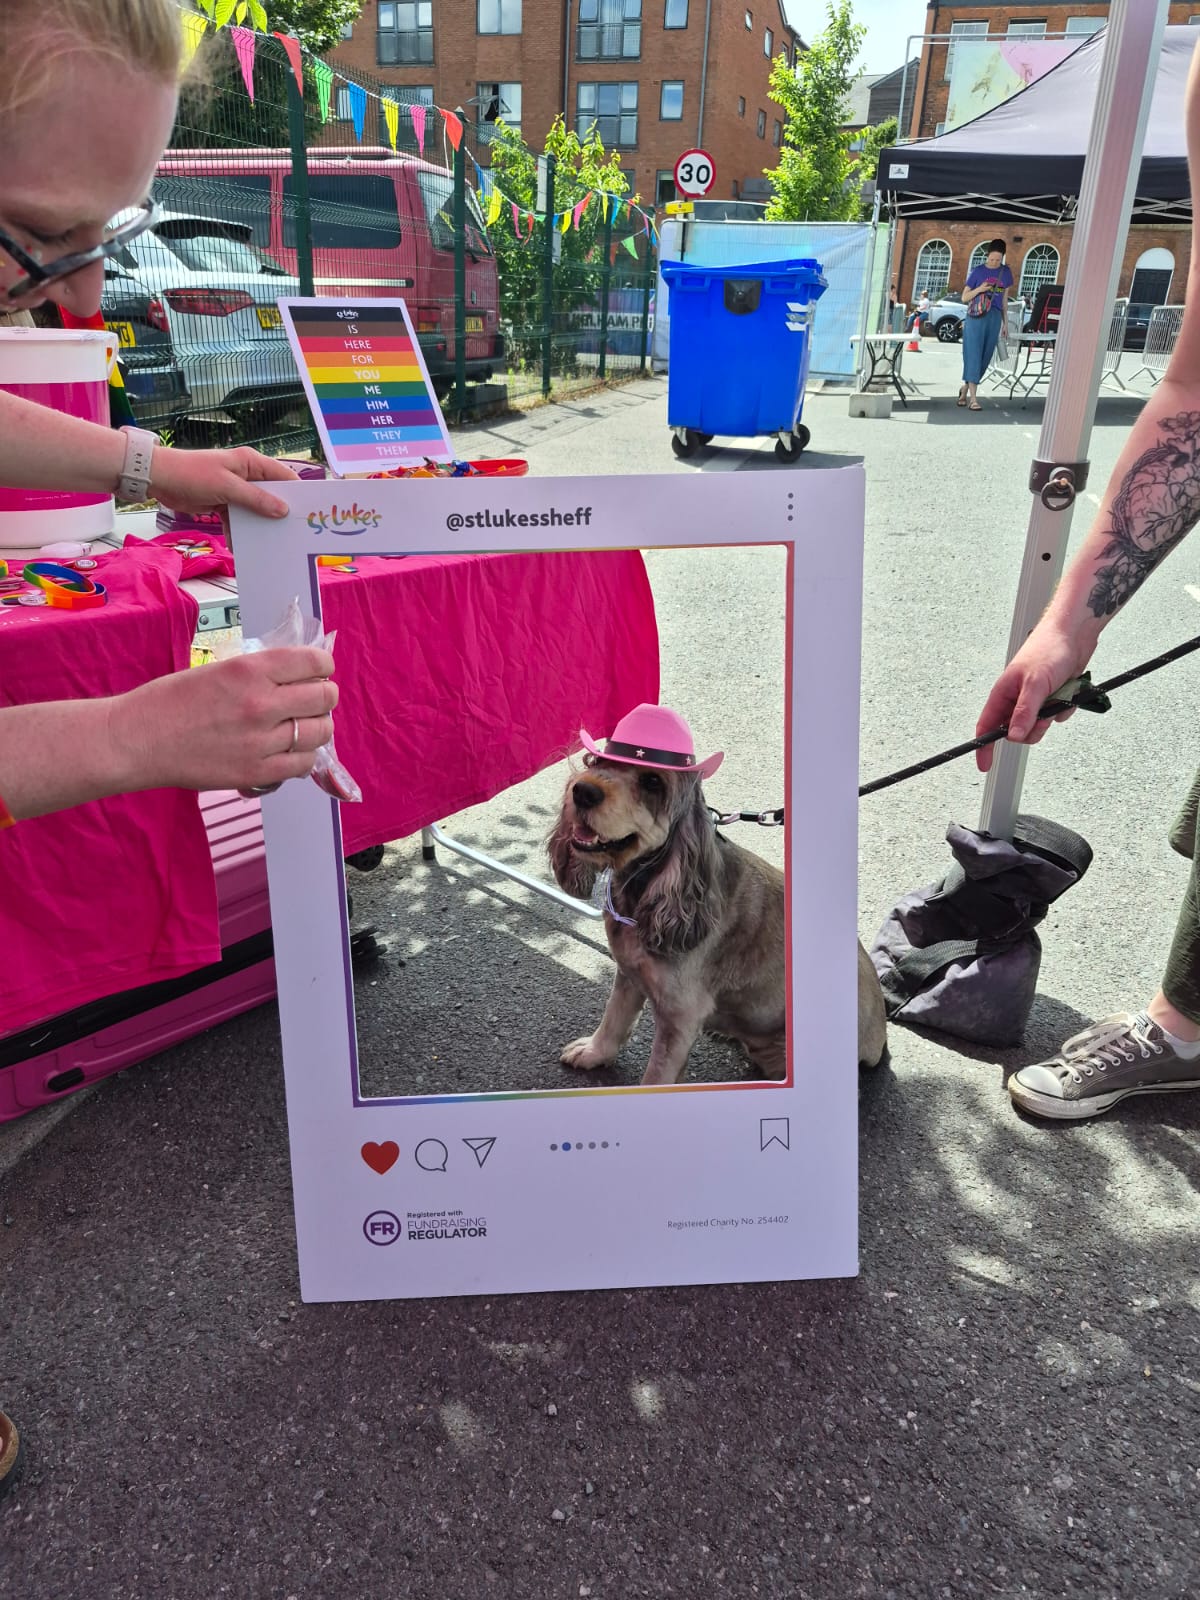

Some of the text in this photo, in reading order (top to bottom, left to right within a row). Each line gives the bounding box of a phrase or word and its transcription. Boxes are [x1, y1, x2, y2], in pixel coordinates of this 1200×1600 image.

[680, 163, 710, 184] 30
[348, 325, 358, 334] IS
[344, 340, 372, 349] HERE
[352, 355, 374, 364] FOR
[354, 370, 380, 380] YOU
[364, 385, 381, 395] ME
[366, 401, 389, 410] HIM
[371, 415, 394, 425] HER
[373, 430, 401, 440] THEY
[376, 446, 408, 456] THEM
[446, 507, 593, 532] @stlukessheff
[407, 1211, 446, 1219] Registered
[407, 1217, 487, 1230] FUNDRAISING
[667, 1219, 709, 1230] Registered
[710, 1218, 739, 1227] Charity
[757, 1215, 789, 1225] 254402
[370, 1221, 395, 1236] FR
[408, 1227, 487, 1240] REGULATOR
